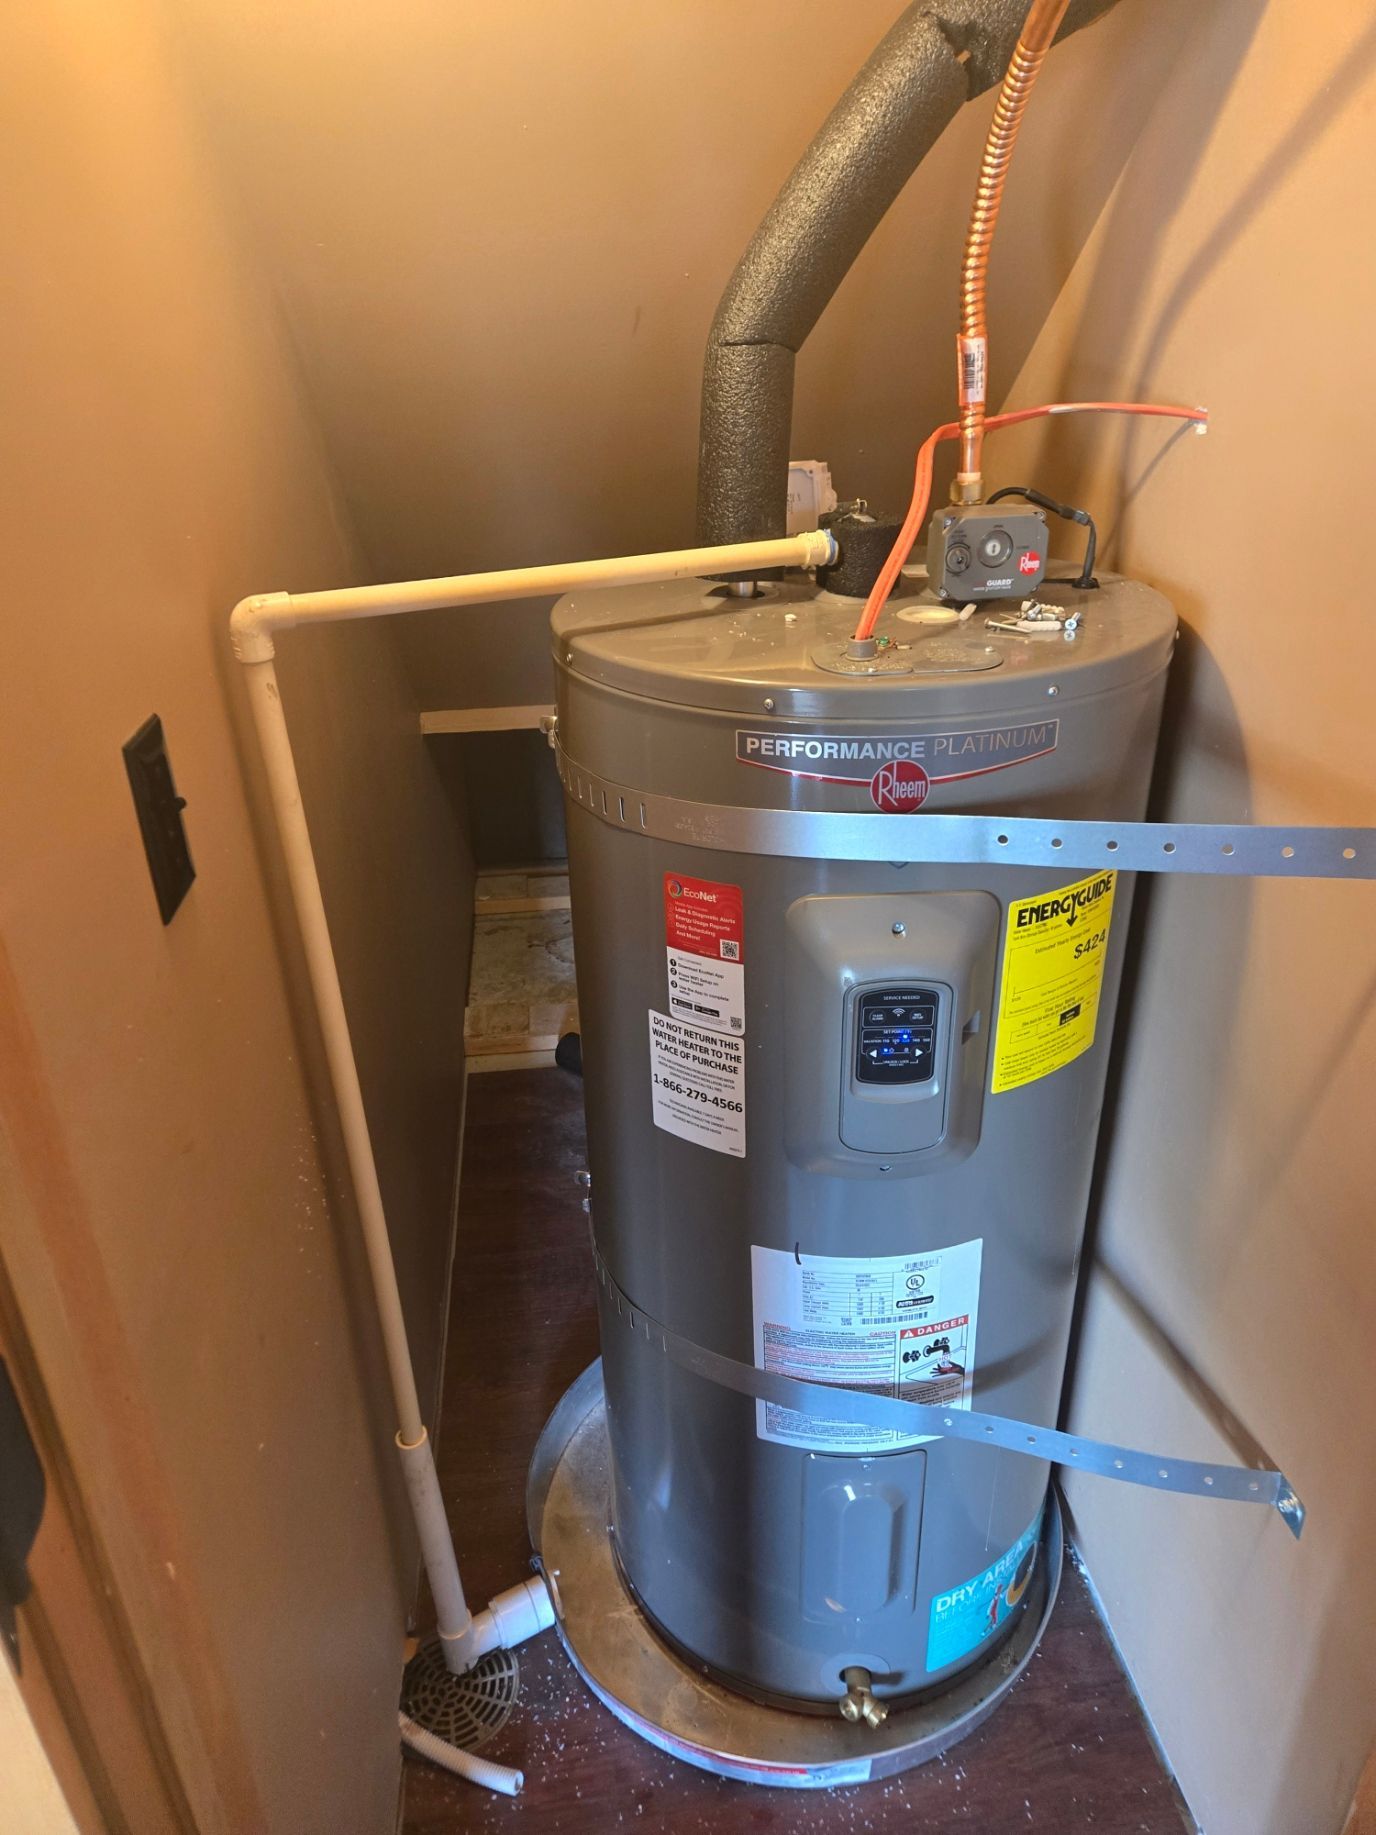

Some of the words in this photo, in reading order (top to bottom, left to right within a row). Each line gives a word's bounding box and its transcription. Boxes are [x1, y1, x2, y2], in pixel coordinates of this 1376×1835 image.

[746, 737, 925, 760] PERFORMANCE
[878, 760, 926, 806] Rheem
[684, 887, 718, 903] EcoNet
[1073, 928, 1106, 960] $424
[652, 1027, 677, 1044] WATER
[678, 1038, 709, 1056] HEATER
[711, 1048, 722, 1058] TO
[724, 1053, 742, 1064] THE
[654, 1016, 664, 1027] DO
[666, 1021, 682, 1034] NOT
[683, 1029, 717, 1046] RETURN
[719, 1038, 739, 1051] THIS
[656, 1040, 678, 1056] PLACE
[680, 1050, 691, 1060] OF
[692, 1055, 738, 1074] PURCHASE
[654, 1073, 742, 1113] 1-866-279-4566
[917, 1317, 965, 1335] DANGER
[936, 1581, 978, 1613] DRY
[982, 1541, 1023, 1589] AREA
